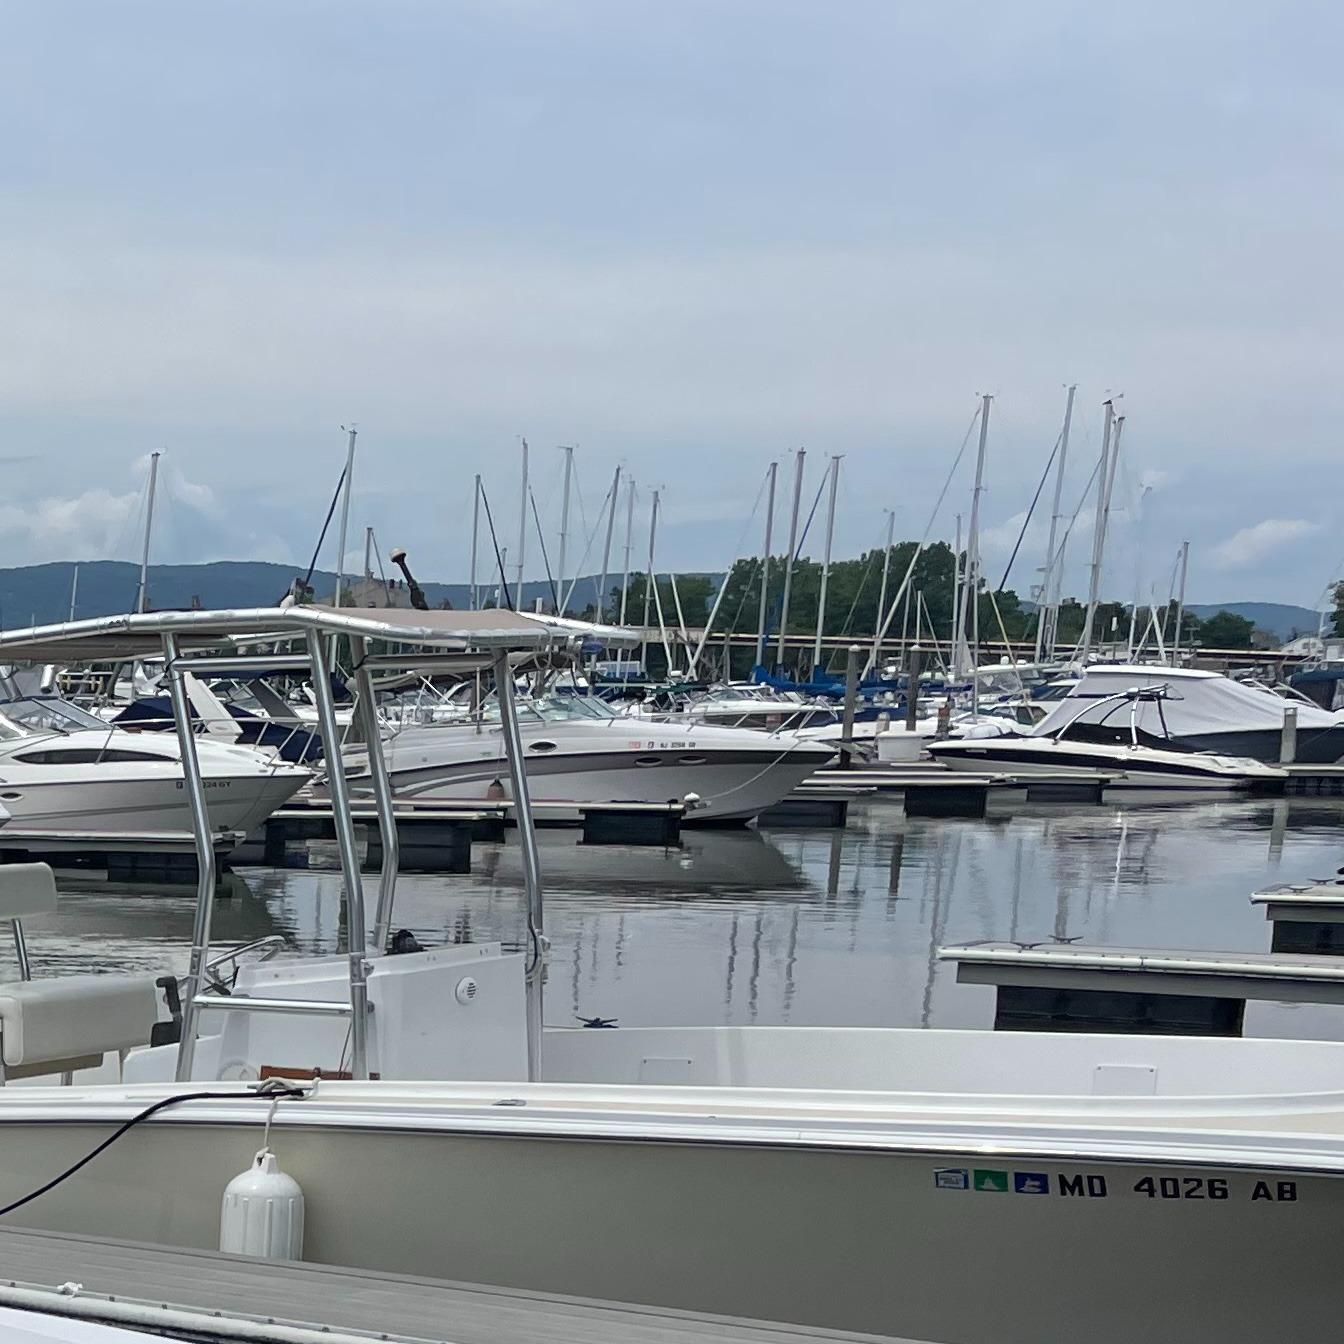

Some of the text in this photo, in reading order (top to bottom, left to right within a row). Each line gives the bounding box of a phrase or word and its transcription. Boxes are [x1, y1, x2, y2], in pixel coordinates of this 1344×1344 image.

[1058, 1173, 1298, 1202] MD 4026 AB
